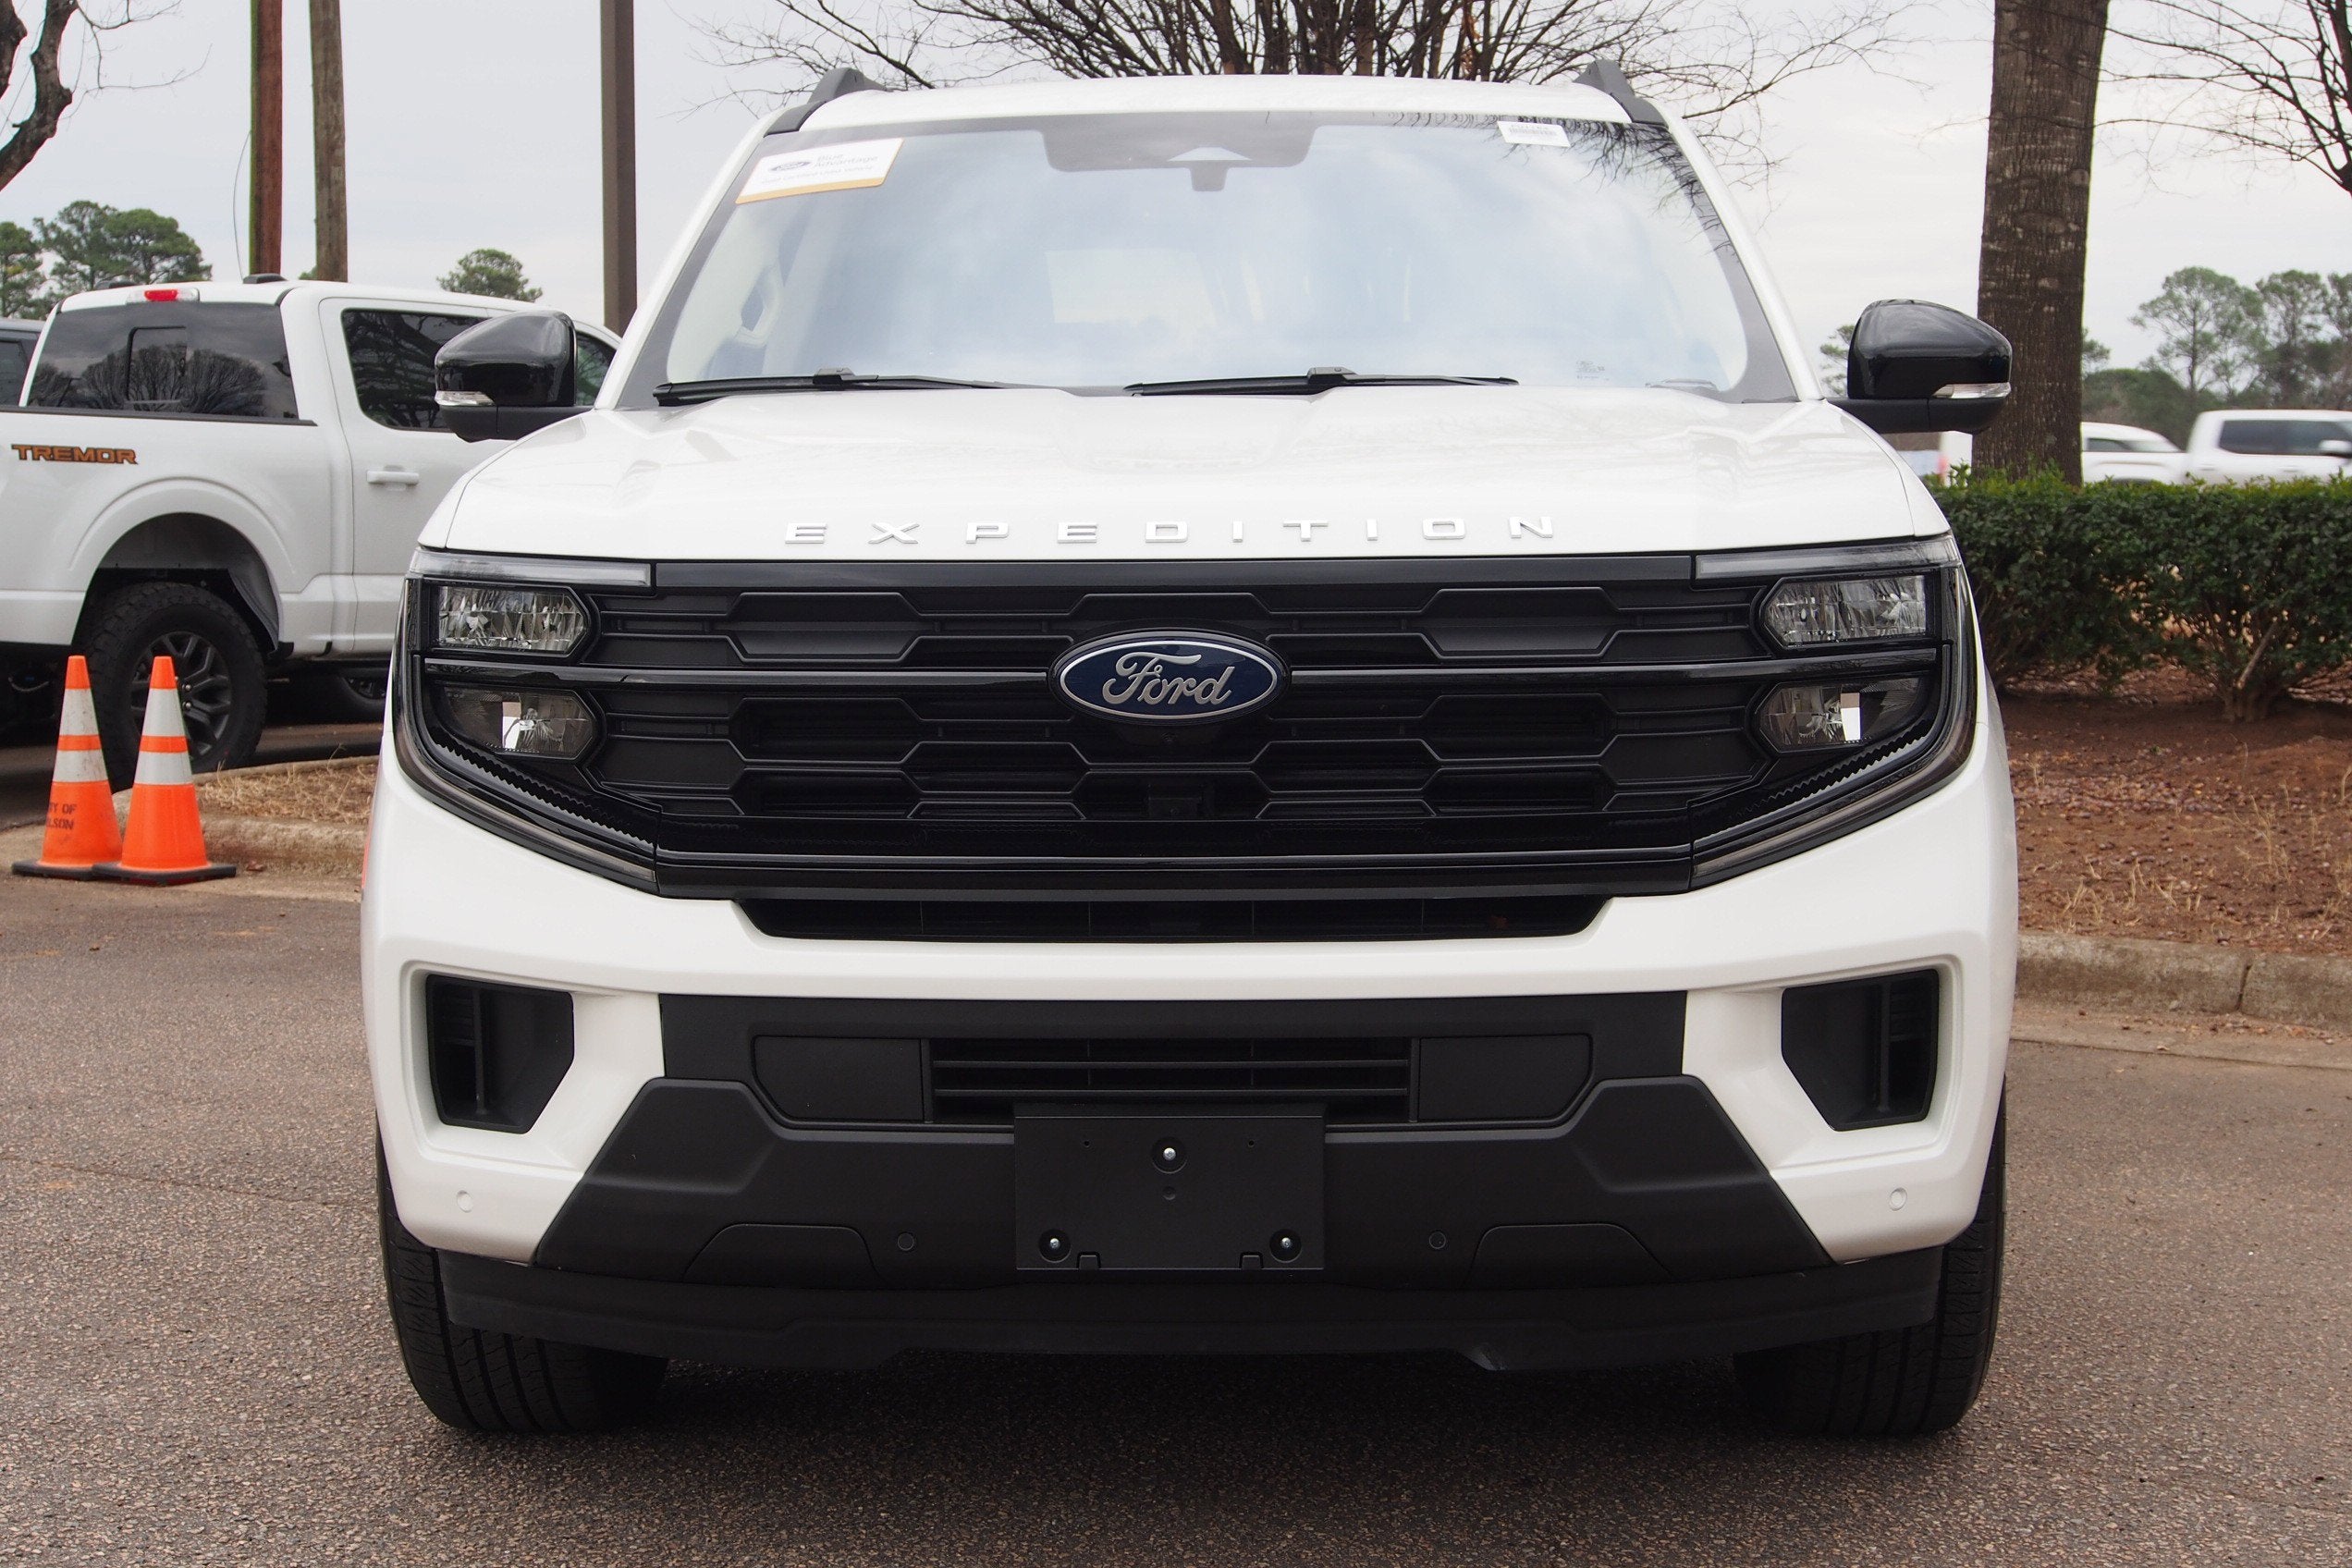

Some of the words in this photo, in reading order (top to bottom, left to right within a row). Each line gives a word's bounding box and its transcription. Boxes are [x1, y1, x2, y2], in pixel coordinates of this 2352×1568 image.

[11, 443, 139, 465] TREMOR
[785, 515, 1555, 545] EXPEDITION
[1101, 653, 1237, 707] Ford
[62, 803, 77, 815] OF
[46, 817, 74, 830] LSON
